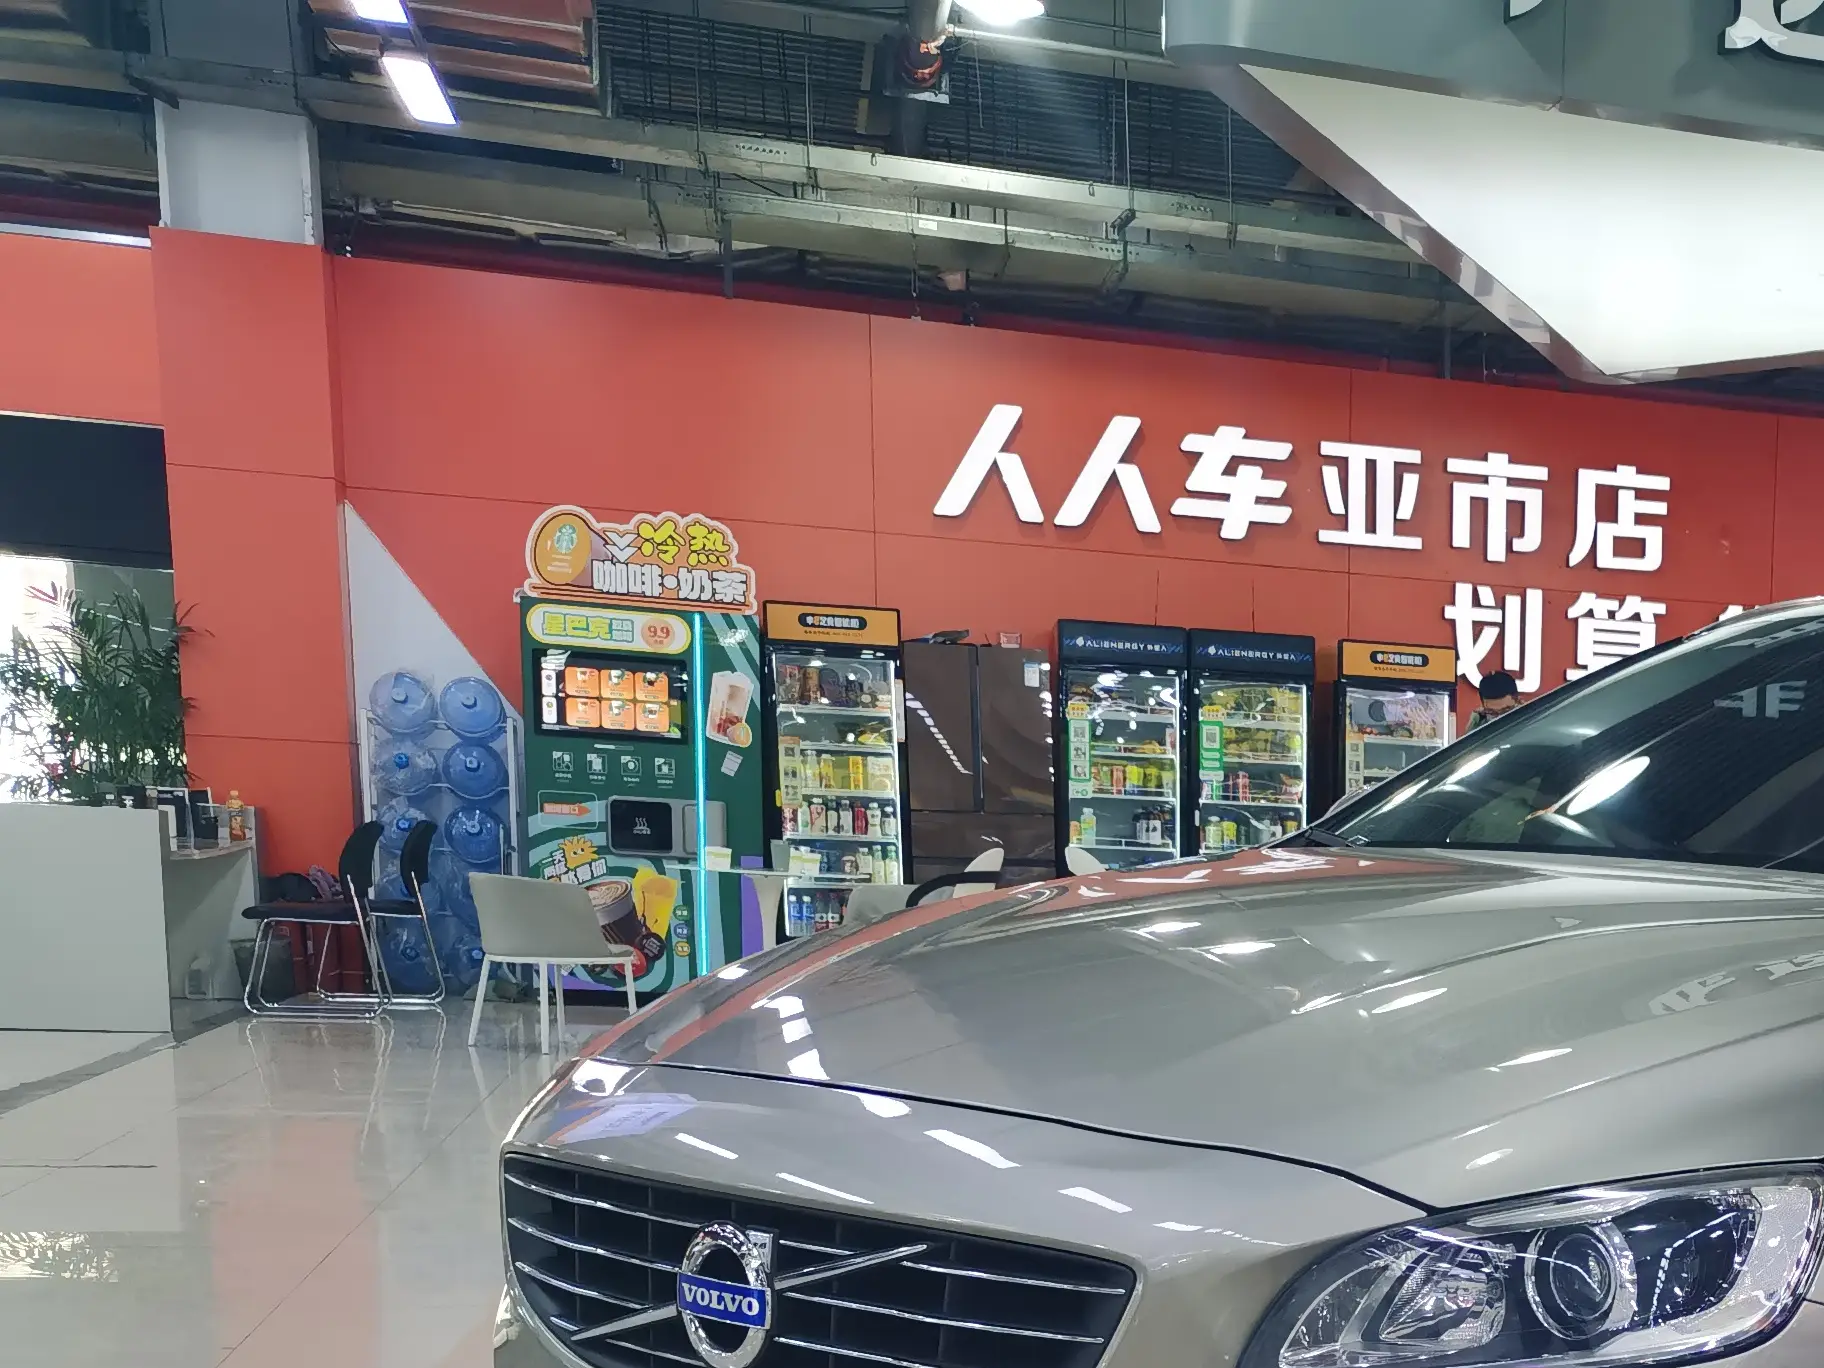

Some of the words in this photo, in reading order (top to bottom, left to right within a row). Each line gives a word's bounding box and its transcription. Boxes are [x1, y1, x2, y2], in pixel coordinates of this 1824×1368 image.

[933, 403, 1671, 573] 人人车亚市店
[638, 519, 731, 567] 冷热
[1444, 582, 1762, 693] 划算
[682, 1283, 760, 1316] VOLVO
